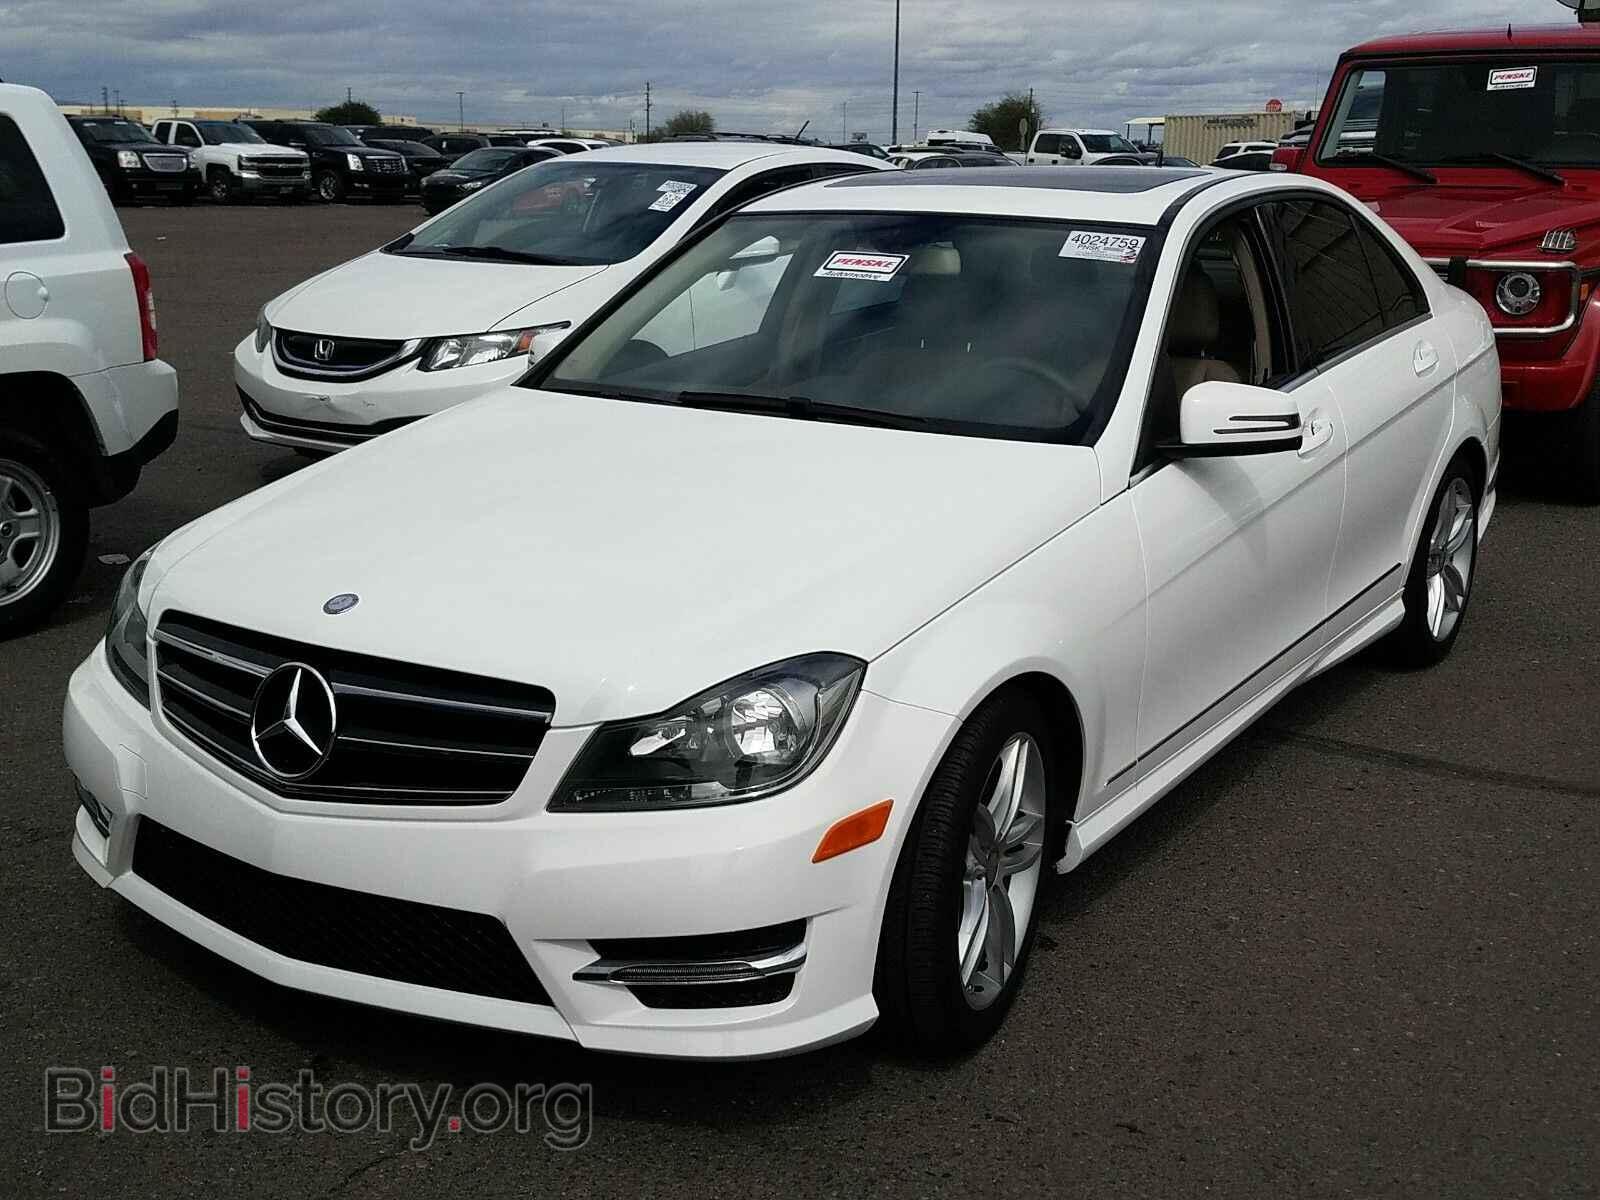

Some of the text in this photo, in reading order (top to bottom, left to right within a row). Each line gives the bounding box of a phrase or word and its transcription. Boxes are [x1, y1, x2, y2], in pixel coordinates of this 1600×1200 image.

[1494, 72, 1532, 80] PENSKE
[1071, 233, 1139, 248] 4024759
[833, 257, 897, 268] PENSKE
